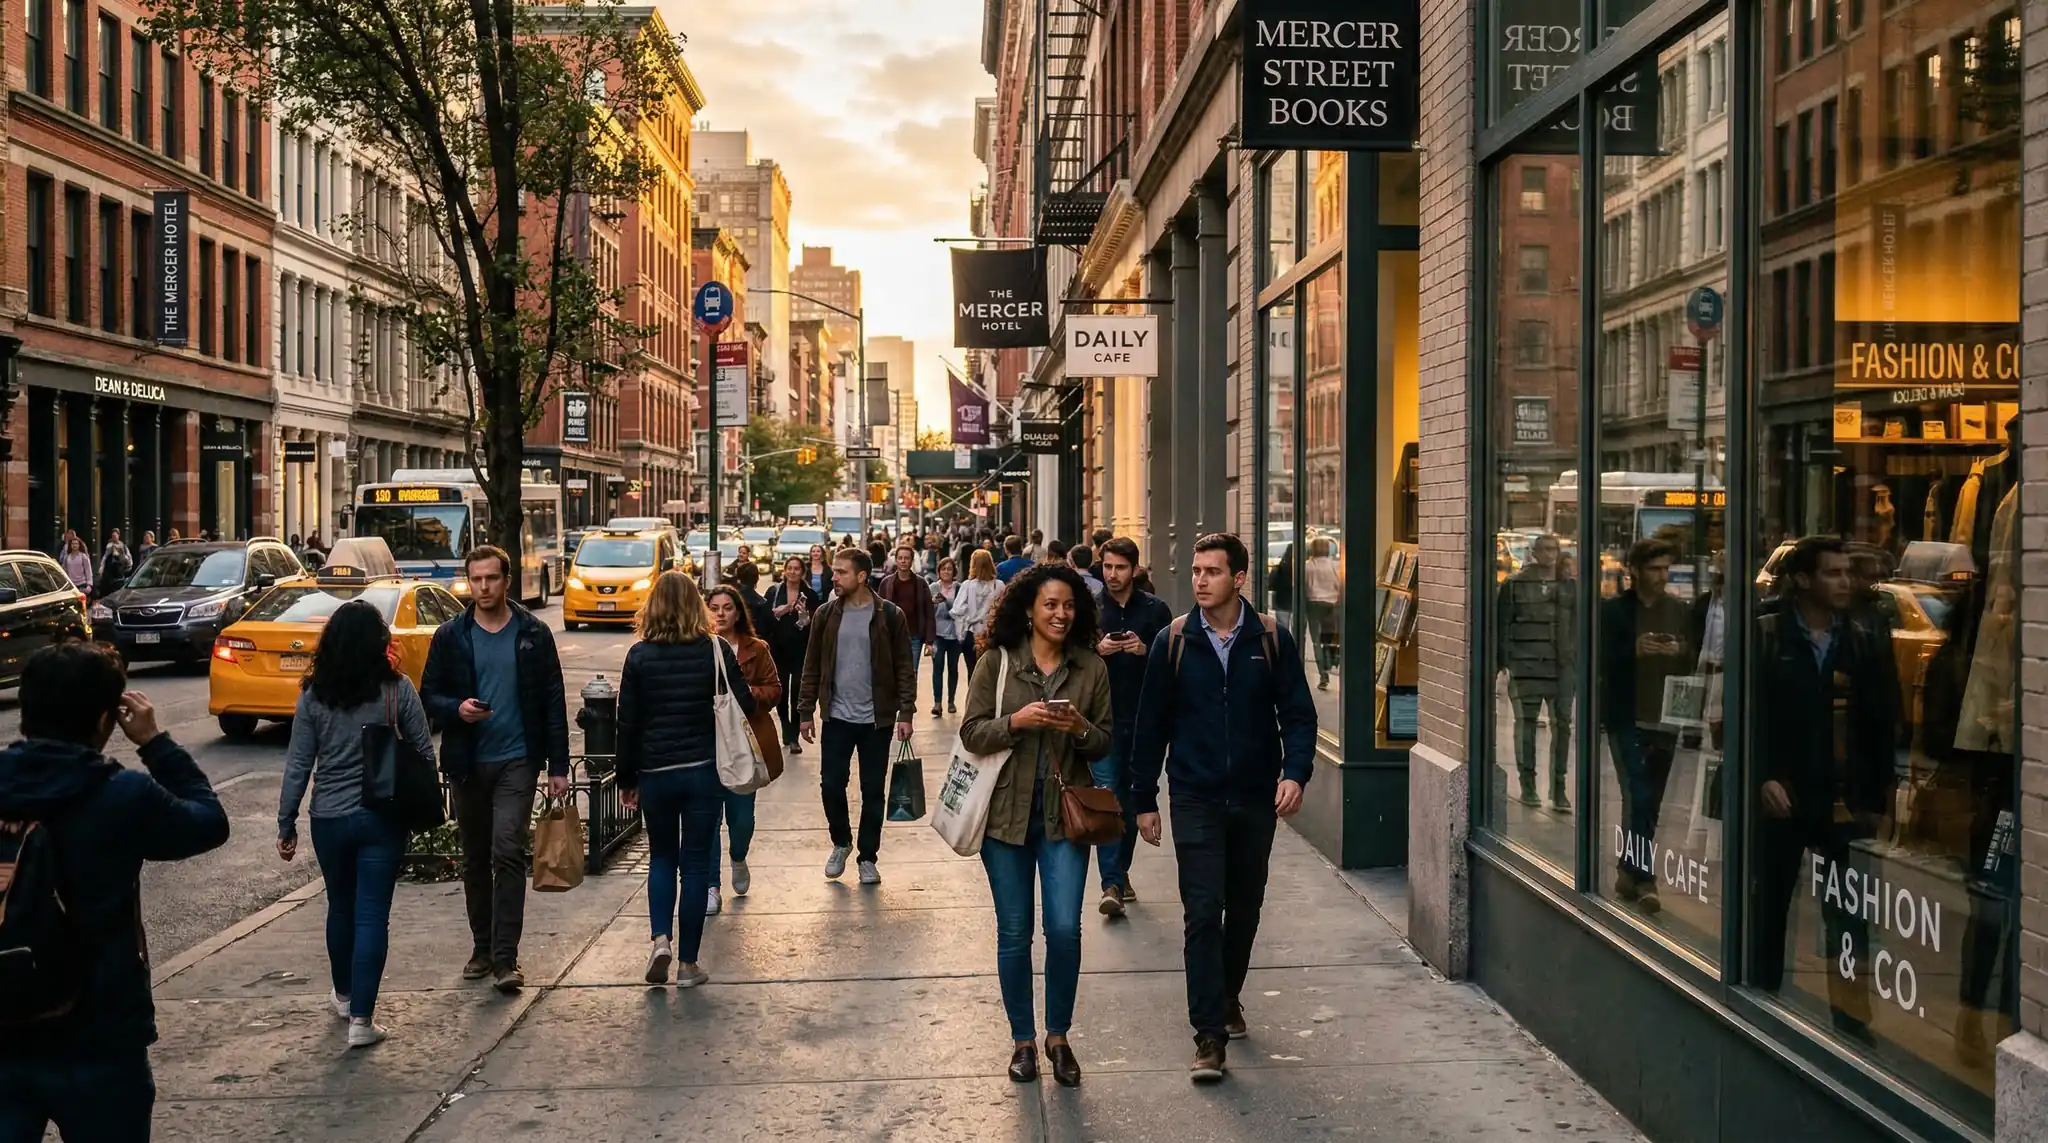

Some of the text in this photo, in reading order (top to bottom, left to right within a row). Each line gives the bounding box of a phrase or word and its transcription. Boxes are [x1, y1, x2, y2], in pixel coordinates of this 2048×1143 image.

[1255, 20, 1402, 49] MERCER
[1263, 59, 1395, 87] STREET
[1268, 98, 1388, 127] BOOKS
[164, 199, 178, 333] THE MERCER HOTEL
[989, 289, 1013, 298] THE
[959, 301, 1044, 319] MERCER
[981, 321, 1022, 331] HOTEL
[1075, 330, 1149, 348] DAILY
[1094, 353, 1131, 363] CAFE
[1851, 342, 1965, 379] FASHION
[1972, 343, 1989, 379] &
[95, 376, 166, 401] DEAN & DELUCA
[1614, 824, 1709, 904] DAILY CAFÉ
[1812, 852, 1941, 952] FASHION
[1839, 931, 1925, 1018] & CO.
